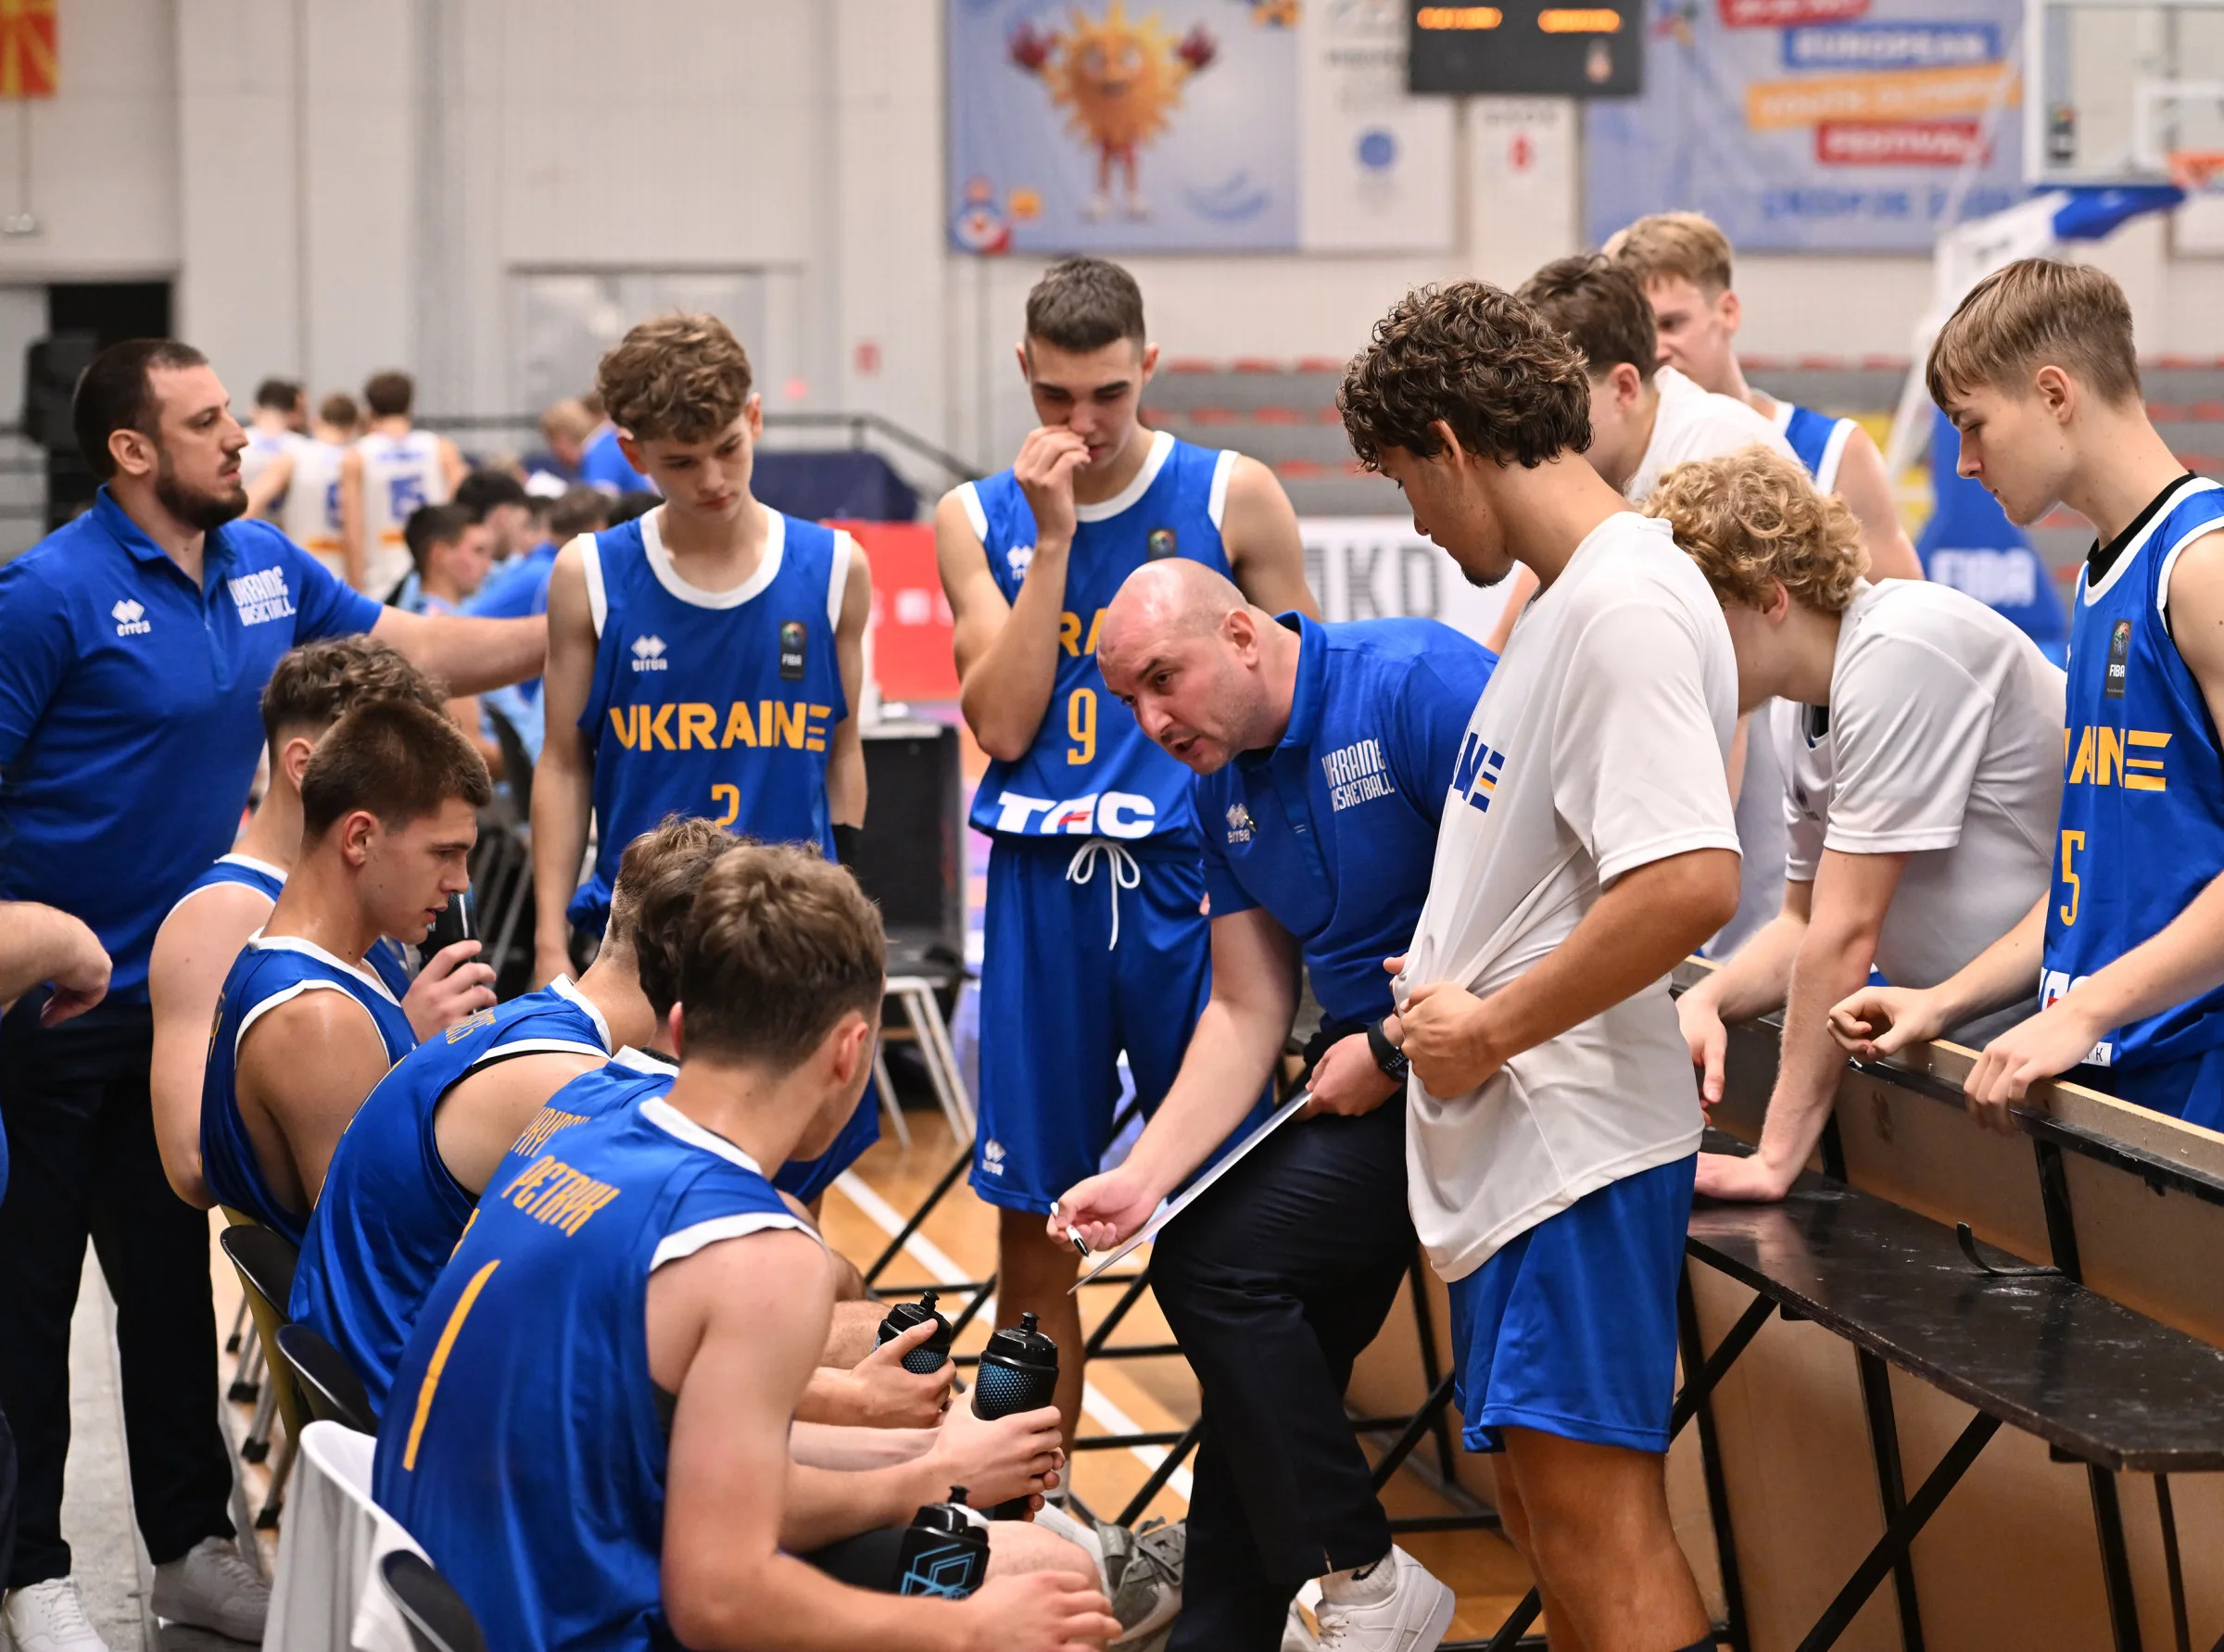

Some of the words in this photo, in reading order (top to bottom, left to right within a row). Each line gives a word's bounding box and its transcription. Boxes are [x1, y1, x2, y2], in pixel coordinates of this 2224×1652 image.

[782, 653, 802, 666] FIBA
[2109, 663, 2126, 678] FIBA
[609, 700, 832, 752] UKRAINE
[1068, 687, 1097, 765] 9
[1320, 738, 1387, 788] UKRAINE
[712, 784, 739, 827] 2
[2061, 829, 2085, 926] 5
[501, 1154, 621, 1238] PETRYK
[402, 1259, 501, 1471] 1
